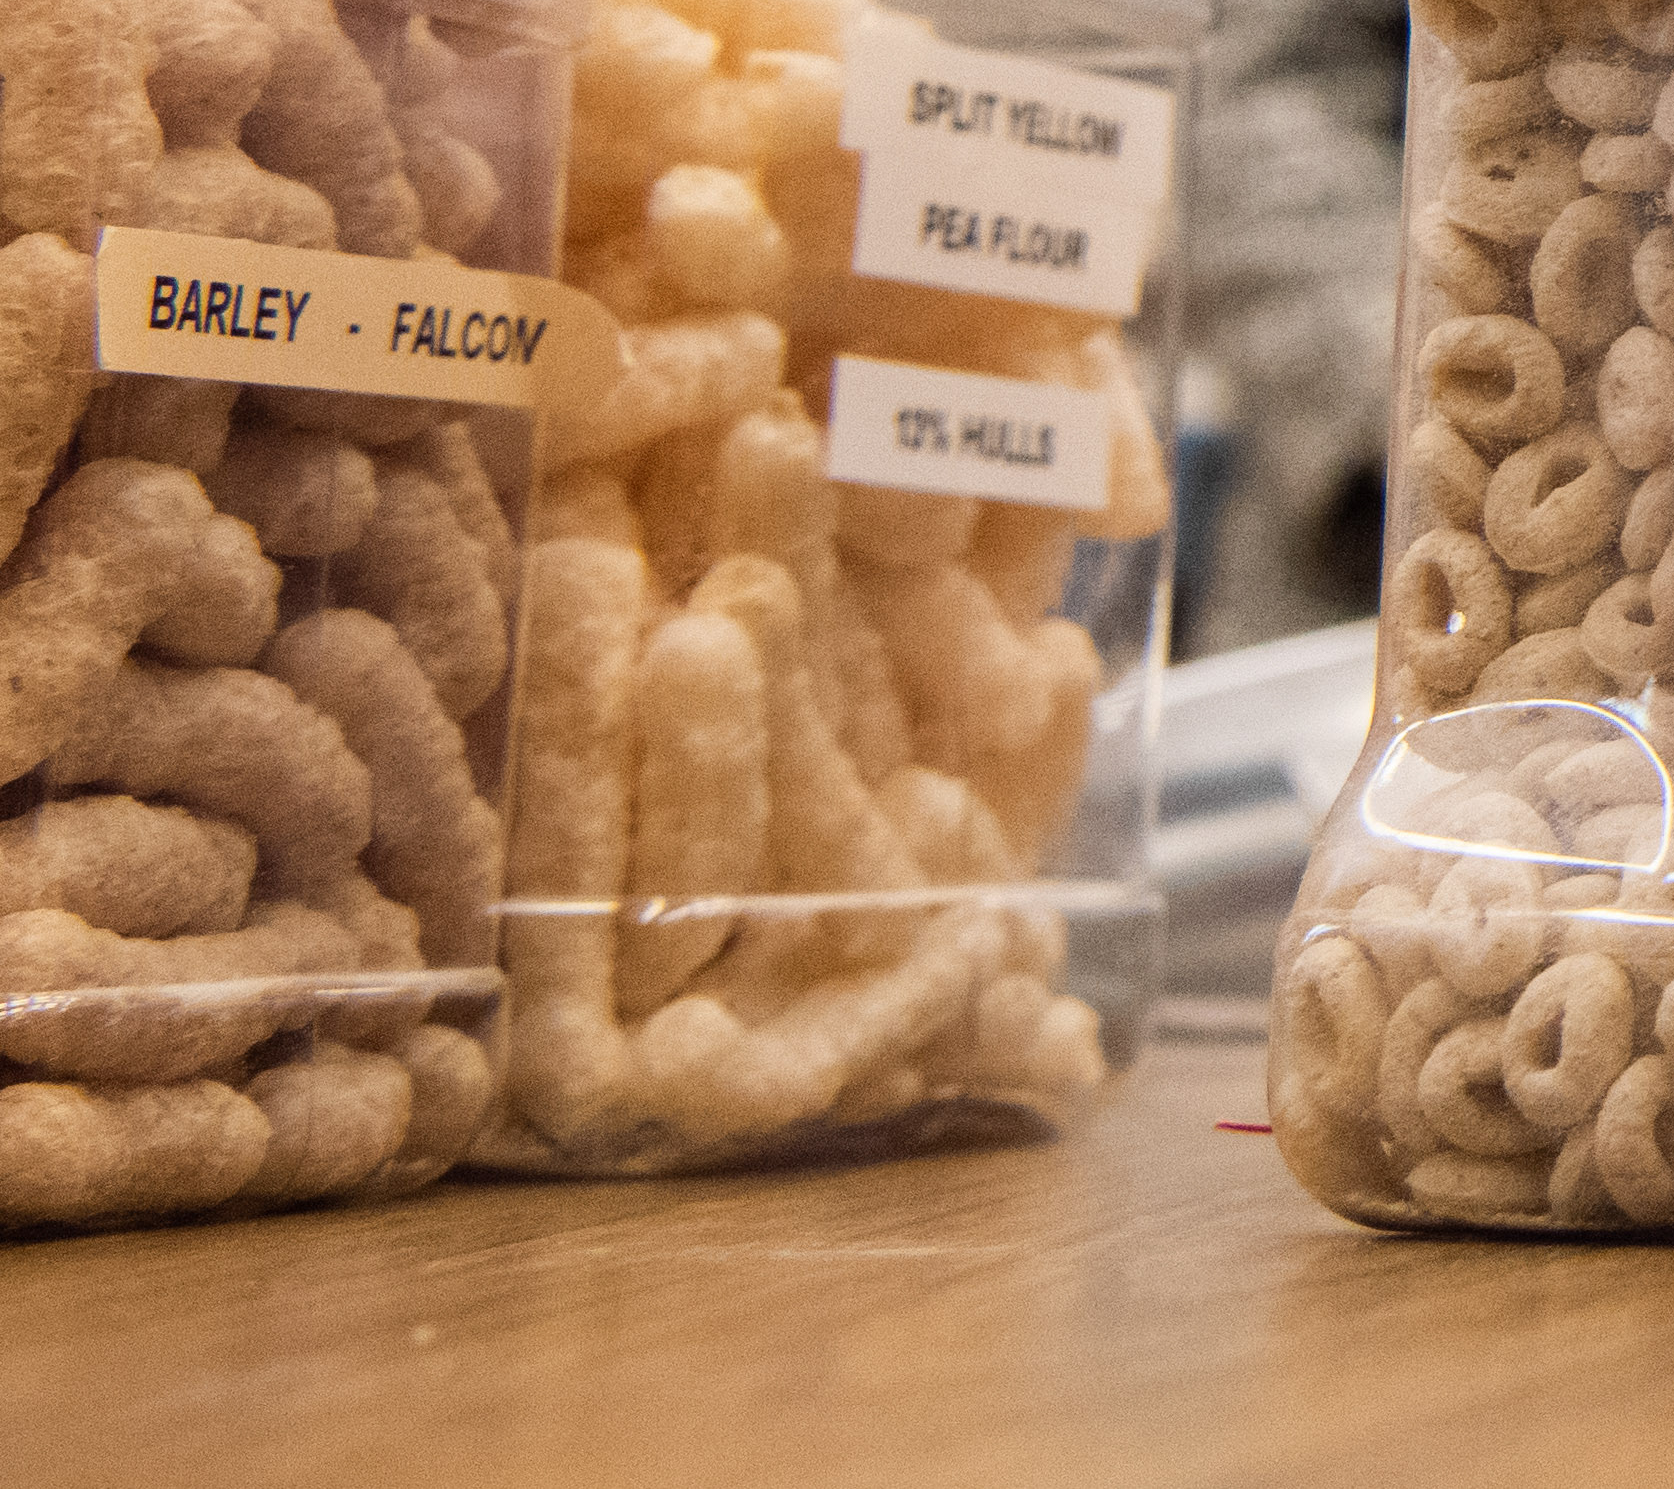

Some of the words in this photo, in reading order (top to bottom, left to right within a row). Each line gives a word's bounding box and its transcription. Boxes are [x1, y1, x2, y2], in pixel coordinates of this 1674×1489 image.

[909, 81, 998, 136] SPLIT
[1004, 100, 1122, 157] YELLOW
[920, 203, 980, 253] PEA
[989, 214, 1088, 270] FLOUR
[148, 275, 311, 342] BARLEY
[388, 302, 547, 364] FALCON
[959, 416, 1056, 464] HULLS
